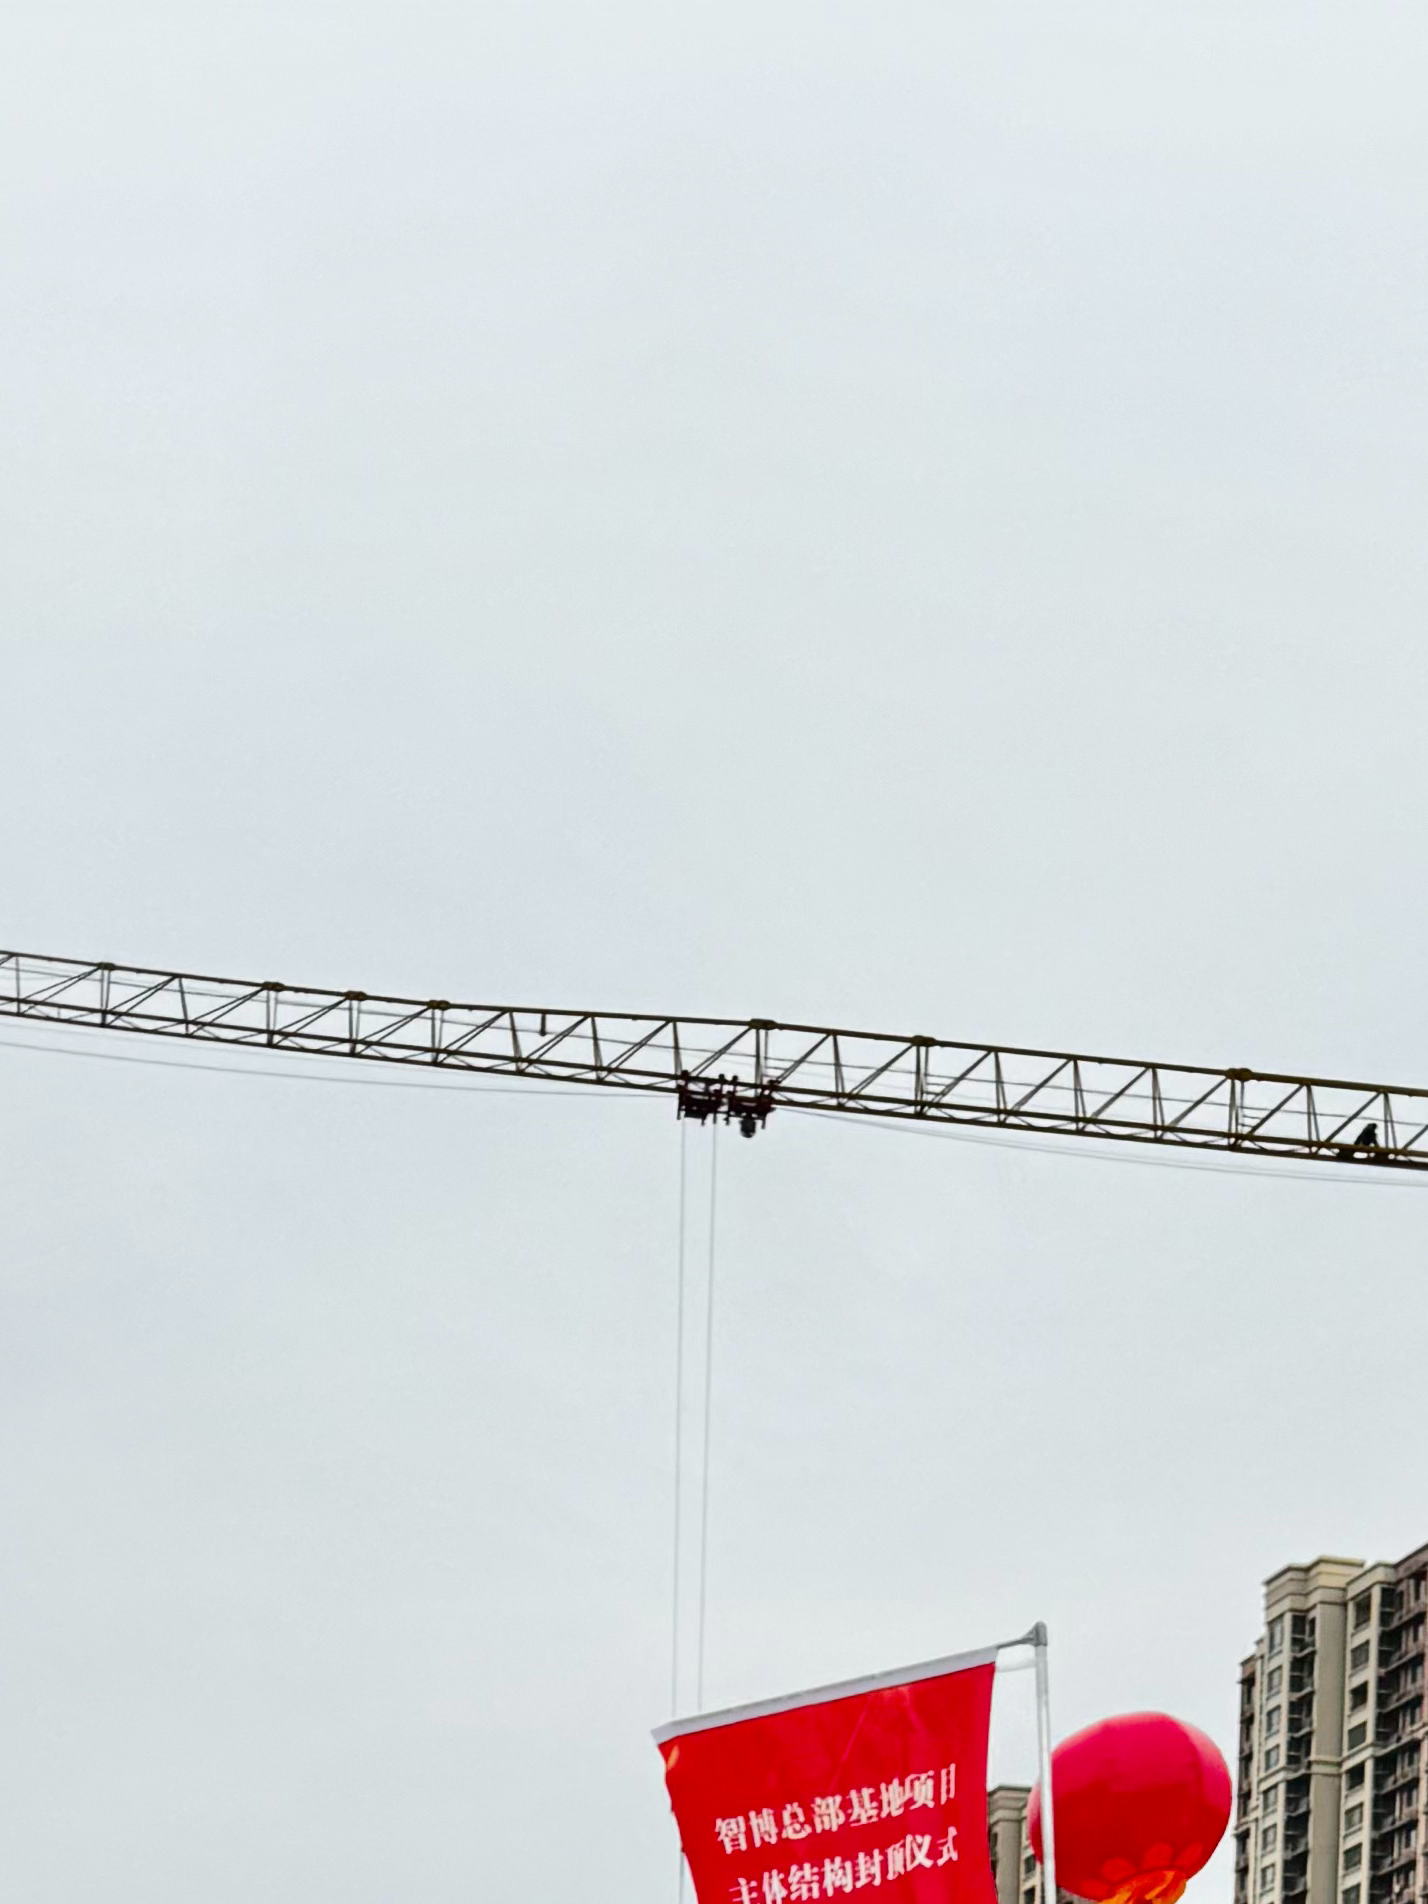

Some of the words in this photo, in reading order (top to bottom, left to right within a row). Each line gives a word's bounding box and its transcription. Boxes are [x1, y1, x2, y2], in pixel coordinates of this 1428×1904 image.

[715, 1763, 956, 1855] 智博总部基地项目
